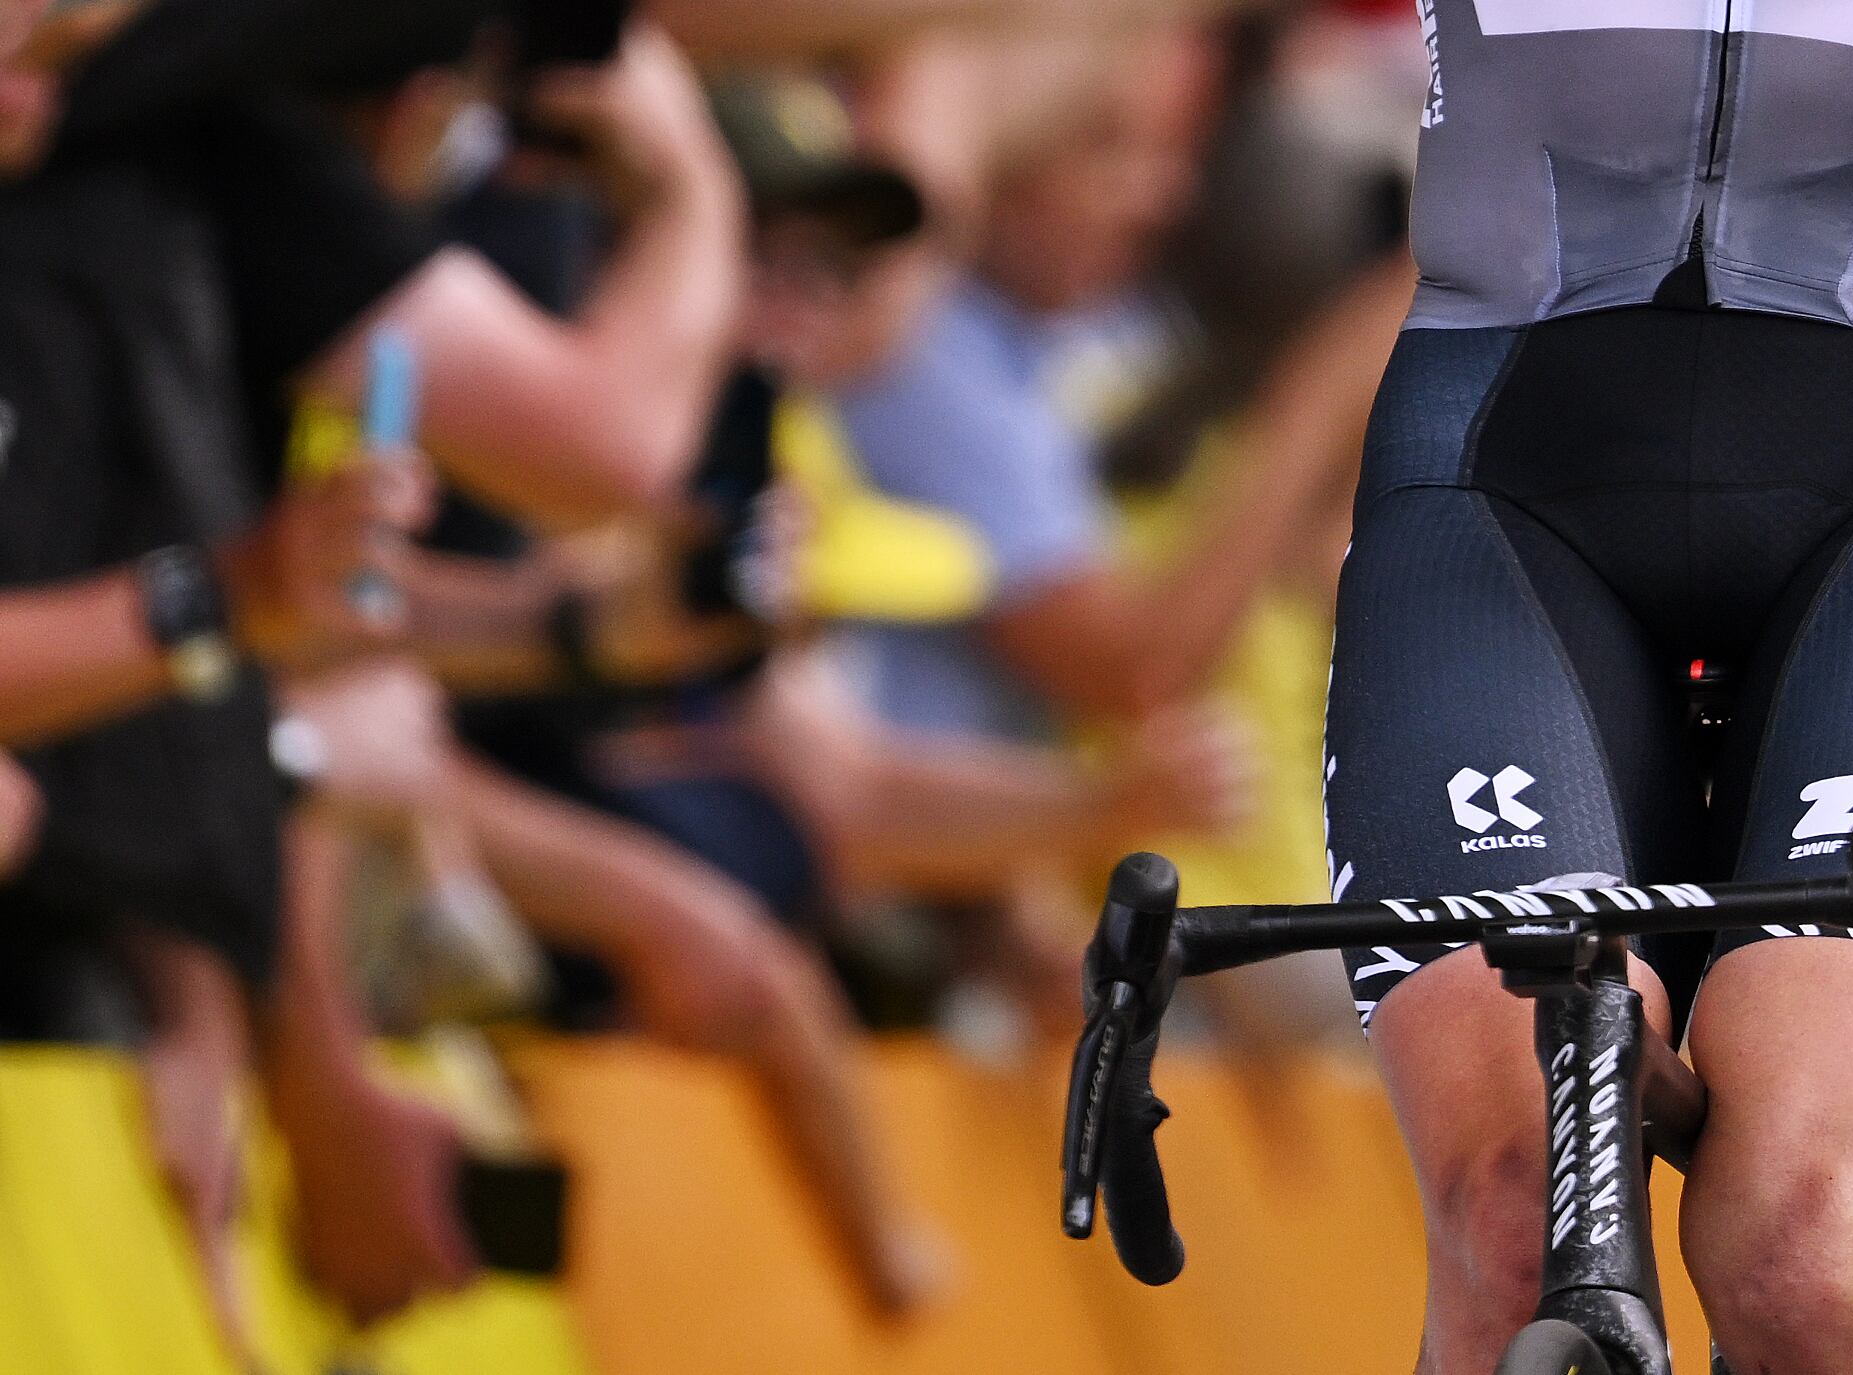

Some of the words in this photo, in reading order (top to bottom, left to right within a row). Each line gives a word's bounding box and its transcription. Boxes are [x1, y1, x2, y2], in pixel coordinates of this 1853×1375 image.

[1787, 840, 1850, 859] ZWIF
[1551, 1042, 1577, 1251] CANYON
[1588, 1044, 1619, 1245] CANYON
